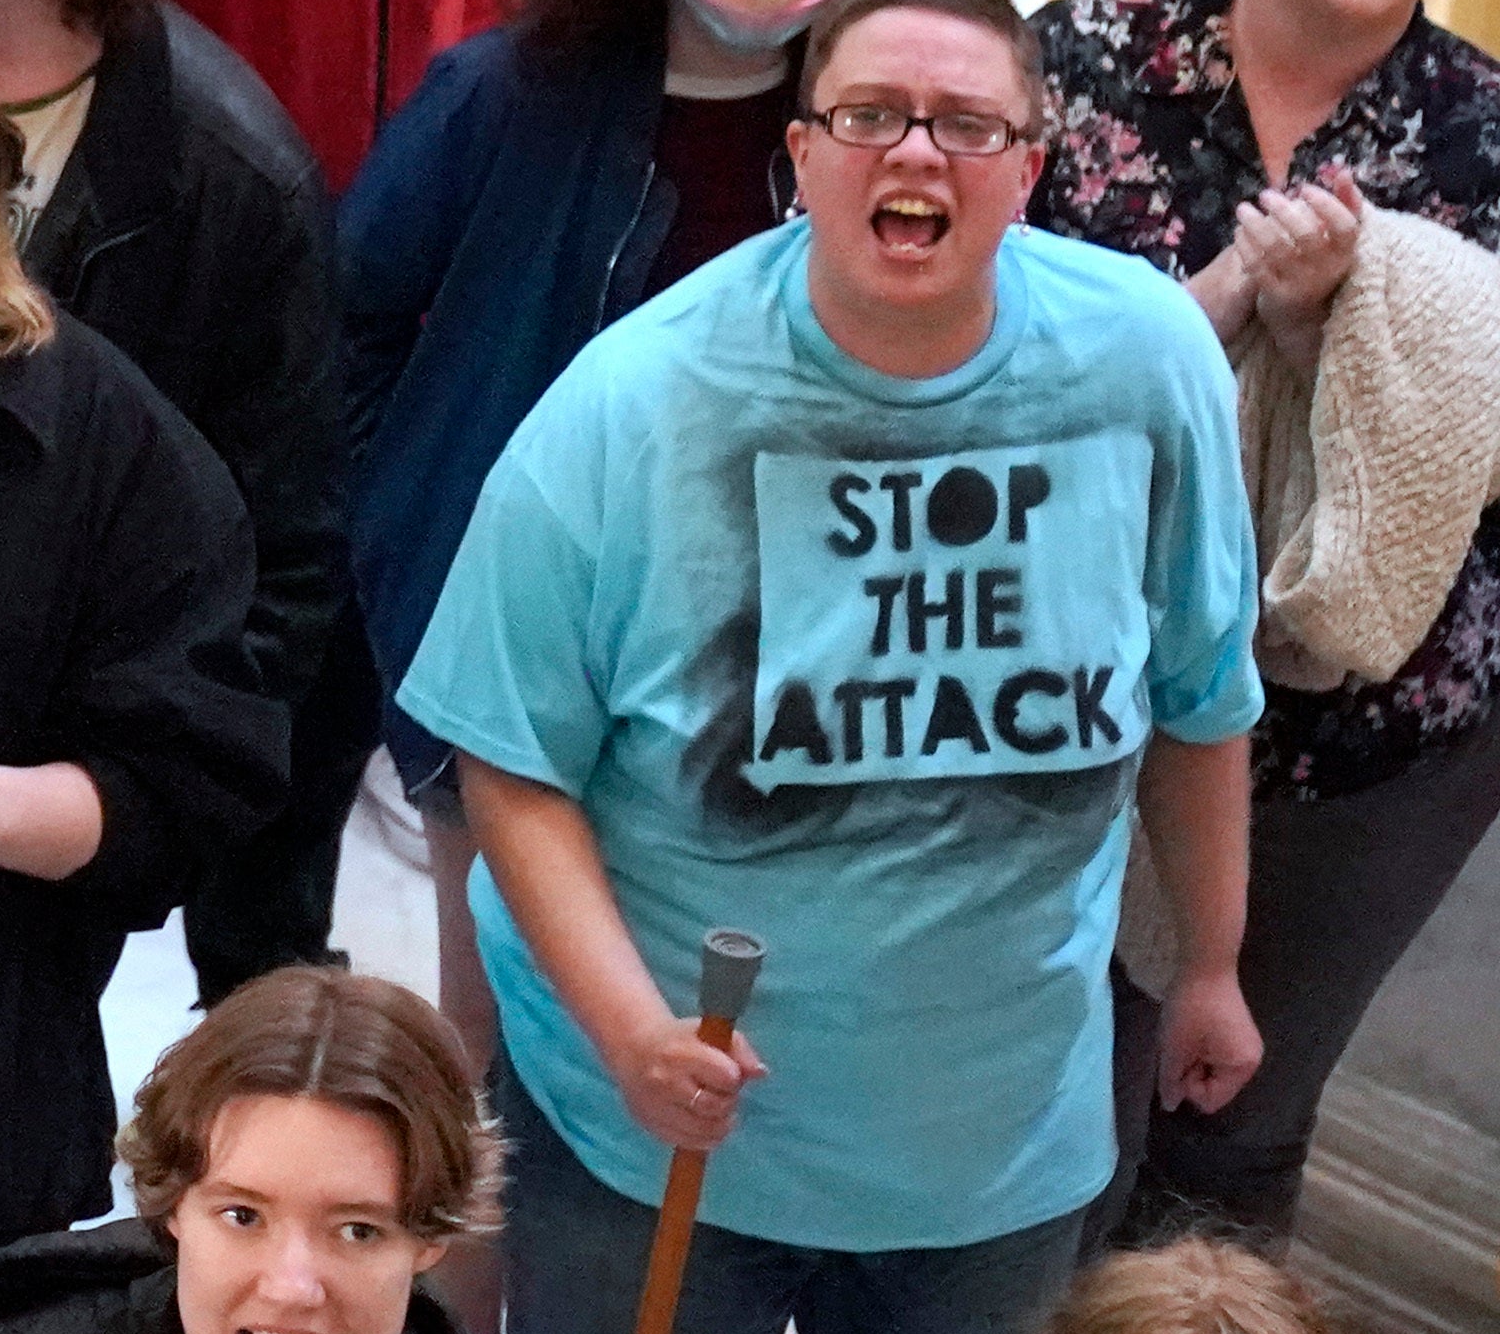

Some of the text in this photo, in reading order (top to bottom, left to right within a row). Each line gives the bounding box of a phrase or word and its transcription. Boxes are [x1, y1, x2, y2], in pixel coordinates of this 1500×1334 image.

[824, 464, 1051, 559] STOP
[863, 568, 1024, 657] THE
[757, 665, 1123, 765] ATTACK
